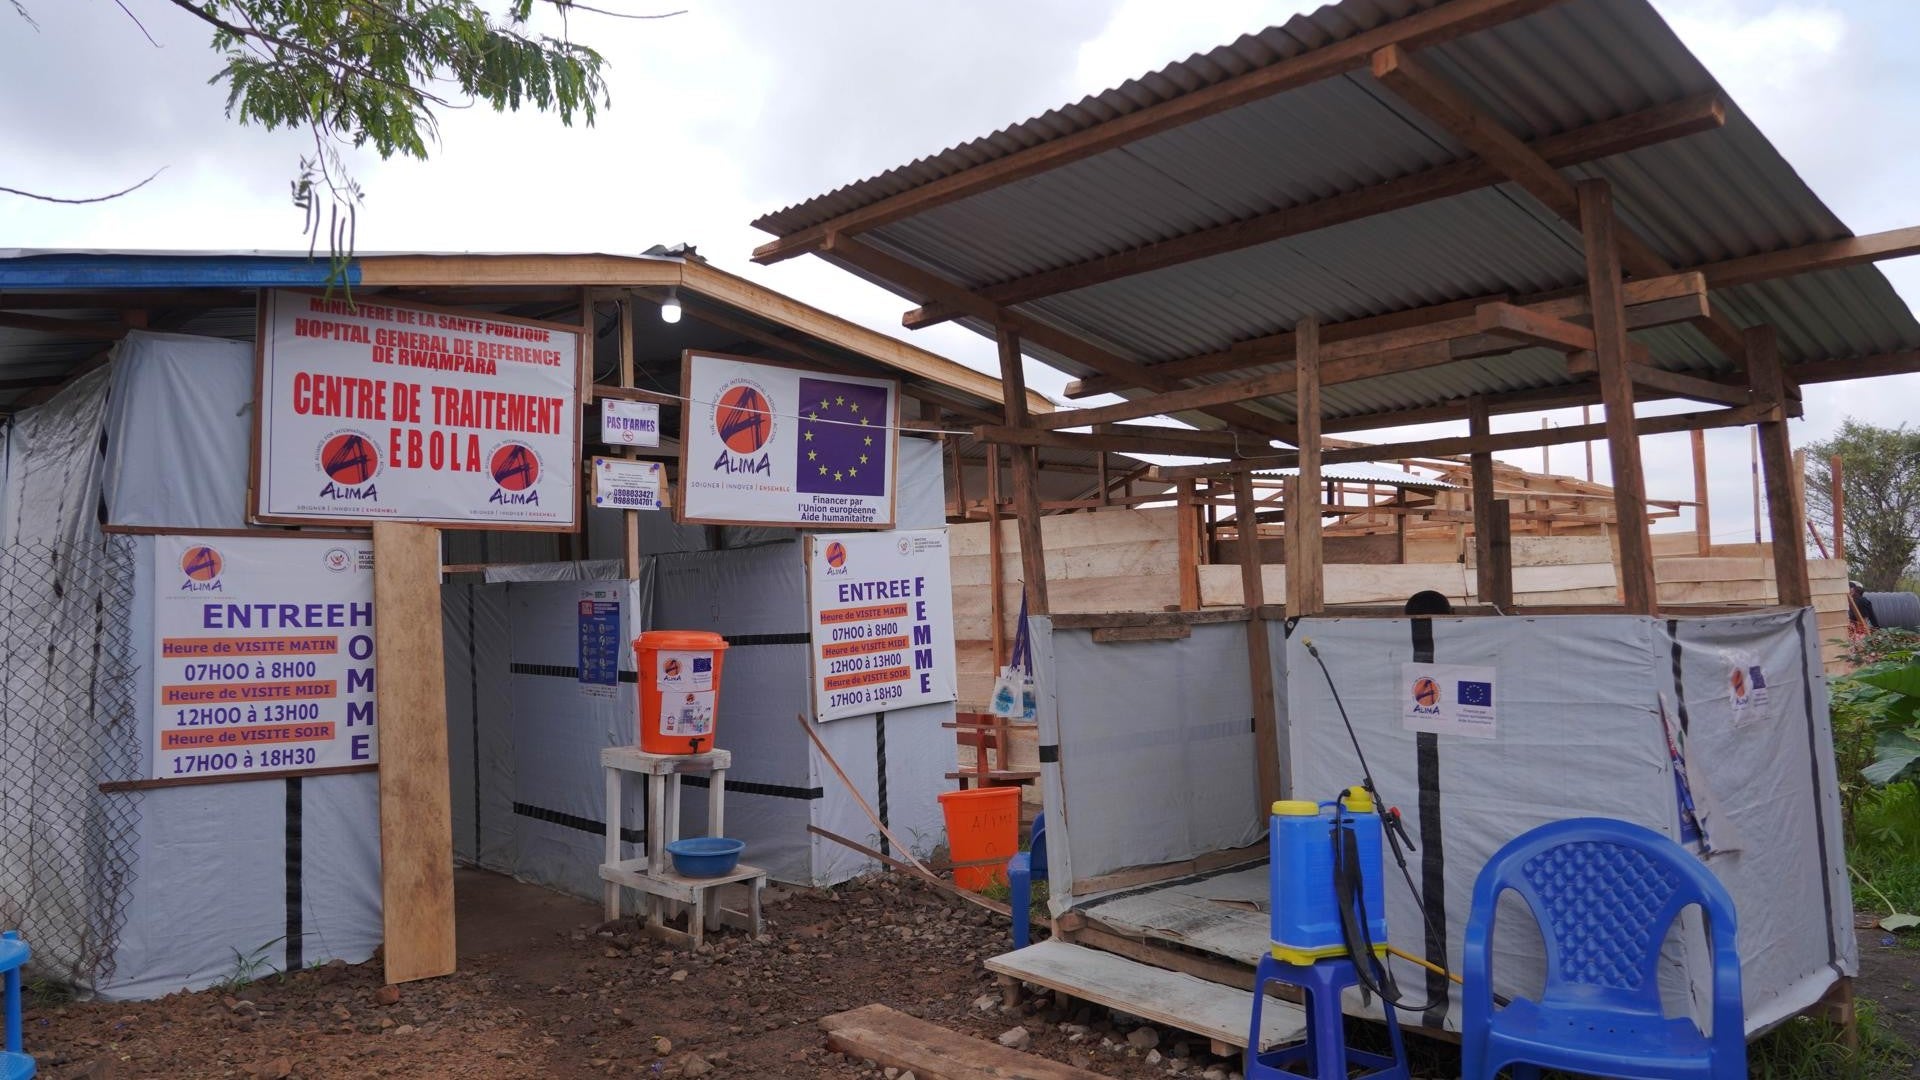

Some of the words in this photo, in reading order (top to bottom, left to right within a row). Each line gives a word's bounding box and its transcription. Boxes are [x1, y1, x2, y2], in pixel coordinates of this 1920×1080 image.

[397, 309, 415, 324] DE
[419, 312, 435, 328] LA
[438, 315, 482, 334] SANTE
[485, 322, 550, 343] PUBLIQUE
[295, 318, 371, 344] HOPITAL
[375, 328, 449, 353] GENERAL
[453, 338, 474, 356] DE
[477, 341, 561, 367] REFERENCE
[372, 345, 393, 364] DE
[398, 348, 497, 375] RWAMPARA
[293, 372, 386, 421] CENTRE
[392, 382, 421, 423] DE
[432, 386, 564, 435] TRAITEMENT
[607, 416, 621, 430] PAS
[623, 418, 655, 432] D'ARMES
[389, 428, 481, 473] EBOLA
[714, 449, 770, 477] ALIMA
[320, 481, 378, 502] ALIMA
[725, 483, 753, 491] INNOVER
[489, 488, 539, 506] ALIMA
[812, 496, 847, 505] Financer
[798, 504, 827, 512] l'Union
[829, 505, 876, 515] européenne
[801, 513, 819, 521] Aide
[826, 566, 848, 576] ALIMA
[181, 579, 222, 592] ALIMA
[839, 579, 910, 602] ENTREE
[203, 603, 344, 629] ENTREE
[820, 611, 843, 621] Heure
[844, 611, 854, 620] de
[855, 609, 881, 618] VISITE
[883, 606, 907, 616] MATIN
[867, 624, 873, 638] à
[875, 622, 898, 637] 8H00
[913, 576, 932, 694] FEMME
[163, 643, 208, 654] Heure
[212, 641, 230, 653] de
[235, 640, 285, 652] VISITE
[290, 639, 336, 651] MATIN
[826, 646, 848, 656] Heure
[849, 645, 859, 653] de
[860, 642, 886, 652] VISITE
[887, 639, 906, 649] MIDI
[865, 655, 871, 669] à
[873, 652, 902, 668] 13H00
[255, 661, 265, 679] à
[271, 661, 316, 678] 8H00
[827, 677, 850, 687] Heure
[851, 675, 861, 684] de
[862, 672, 888, 683] VISITE
[889, 669, 908, 680] SOIR
[346, 602, 374, 760] HOMME
[168, 690, 214, 701] Heure
[219, 688, 236, 700] de
[241, 686, 291, 698] VISITE
[295, 684, 331, 696] MIDI
[866, 688, 871, 702] à
[874, 685, 903, 702] 18H30
[247, 704, 257, 723] à
[264, 703, 319, 722] 13H00
[1413, 704, 1440, 715] ALIMA
[168, 734, 214, 745] Heure
[219, 731, 236, 743] de
[241, 728, 290, 741] VISITE
[294, 726, 329, 738] SOIR
[243, 750, 253, 768] à
[260, 747, 316, 767] 18H30
